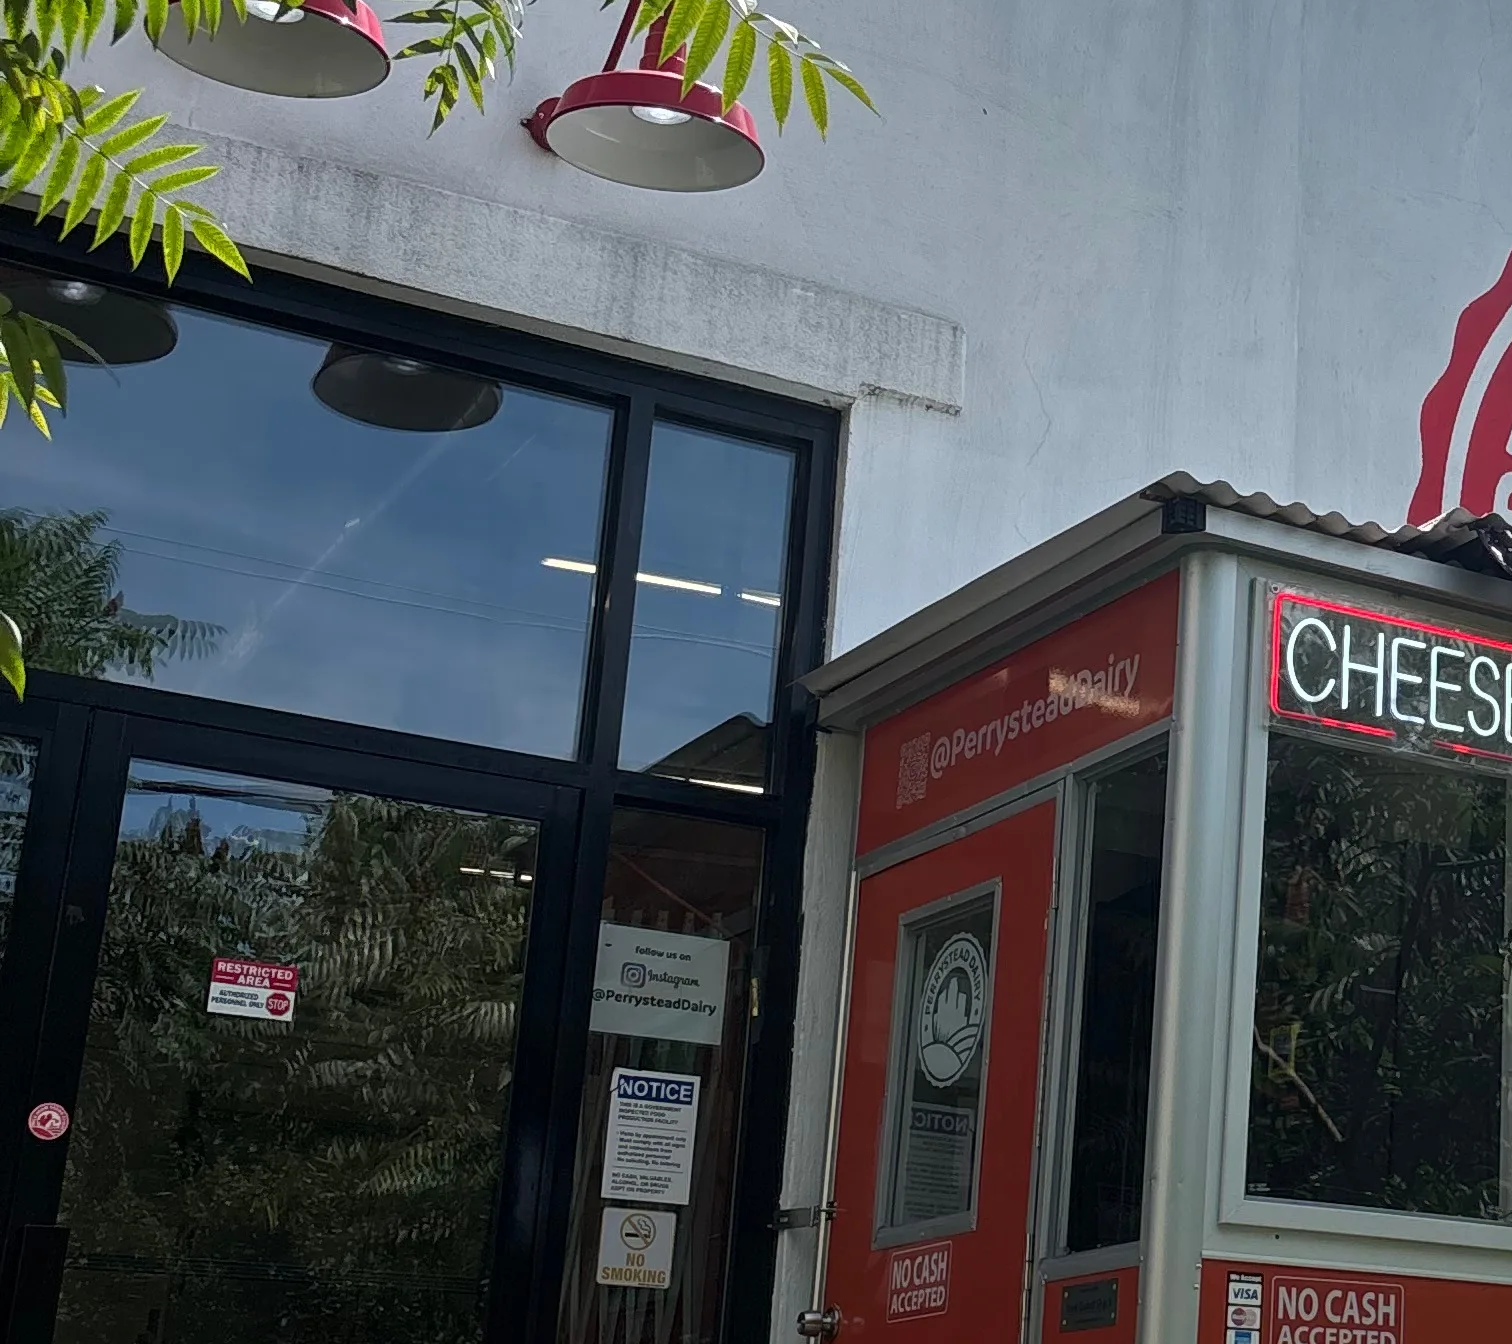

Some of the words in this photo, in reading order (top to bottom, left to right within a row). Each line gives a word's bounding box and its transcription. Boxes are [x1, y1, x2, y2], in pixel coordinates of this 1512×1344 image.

[635, 945, 664, 958] follow
[666, 951, 677, 959] us
[679, 953, 691, 961] on
[217, 961, 294, 981] RESTRICTED
[648, 969, 700, 989] Instagram
[924, 947, 970, 1015] PERRYSTEAD
[968, 956, 983, 1001] DAIRY
[237, 975, 270, 988] AREA
[267, 998, 289, 1011] STOP
[592, 988, 717, 1017] @PerrysteadDairy
[620, 1078, 692, 1102] NOTICE
[626, 1252, 645, 1267] NO
[602, 1267, 666, 1284] SMOKING
[892, 1258, 911, 1290] NO
[913, 1250, 948, 1286] CASH
[890, 1285, 946, 1315] ACCEPTED
[1232, 1287, 1258, 1301] VISA
[1276, 1284, 1318, 1322] NO
[1325, 1288, 1396, 1327] CASH
